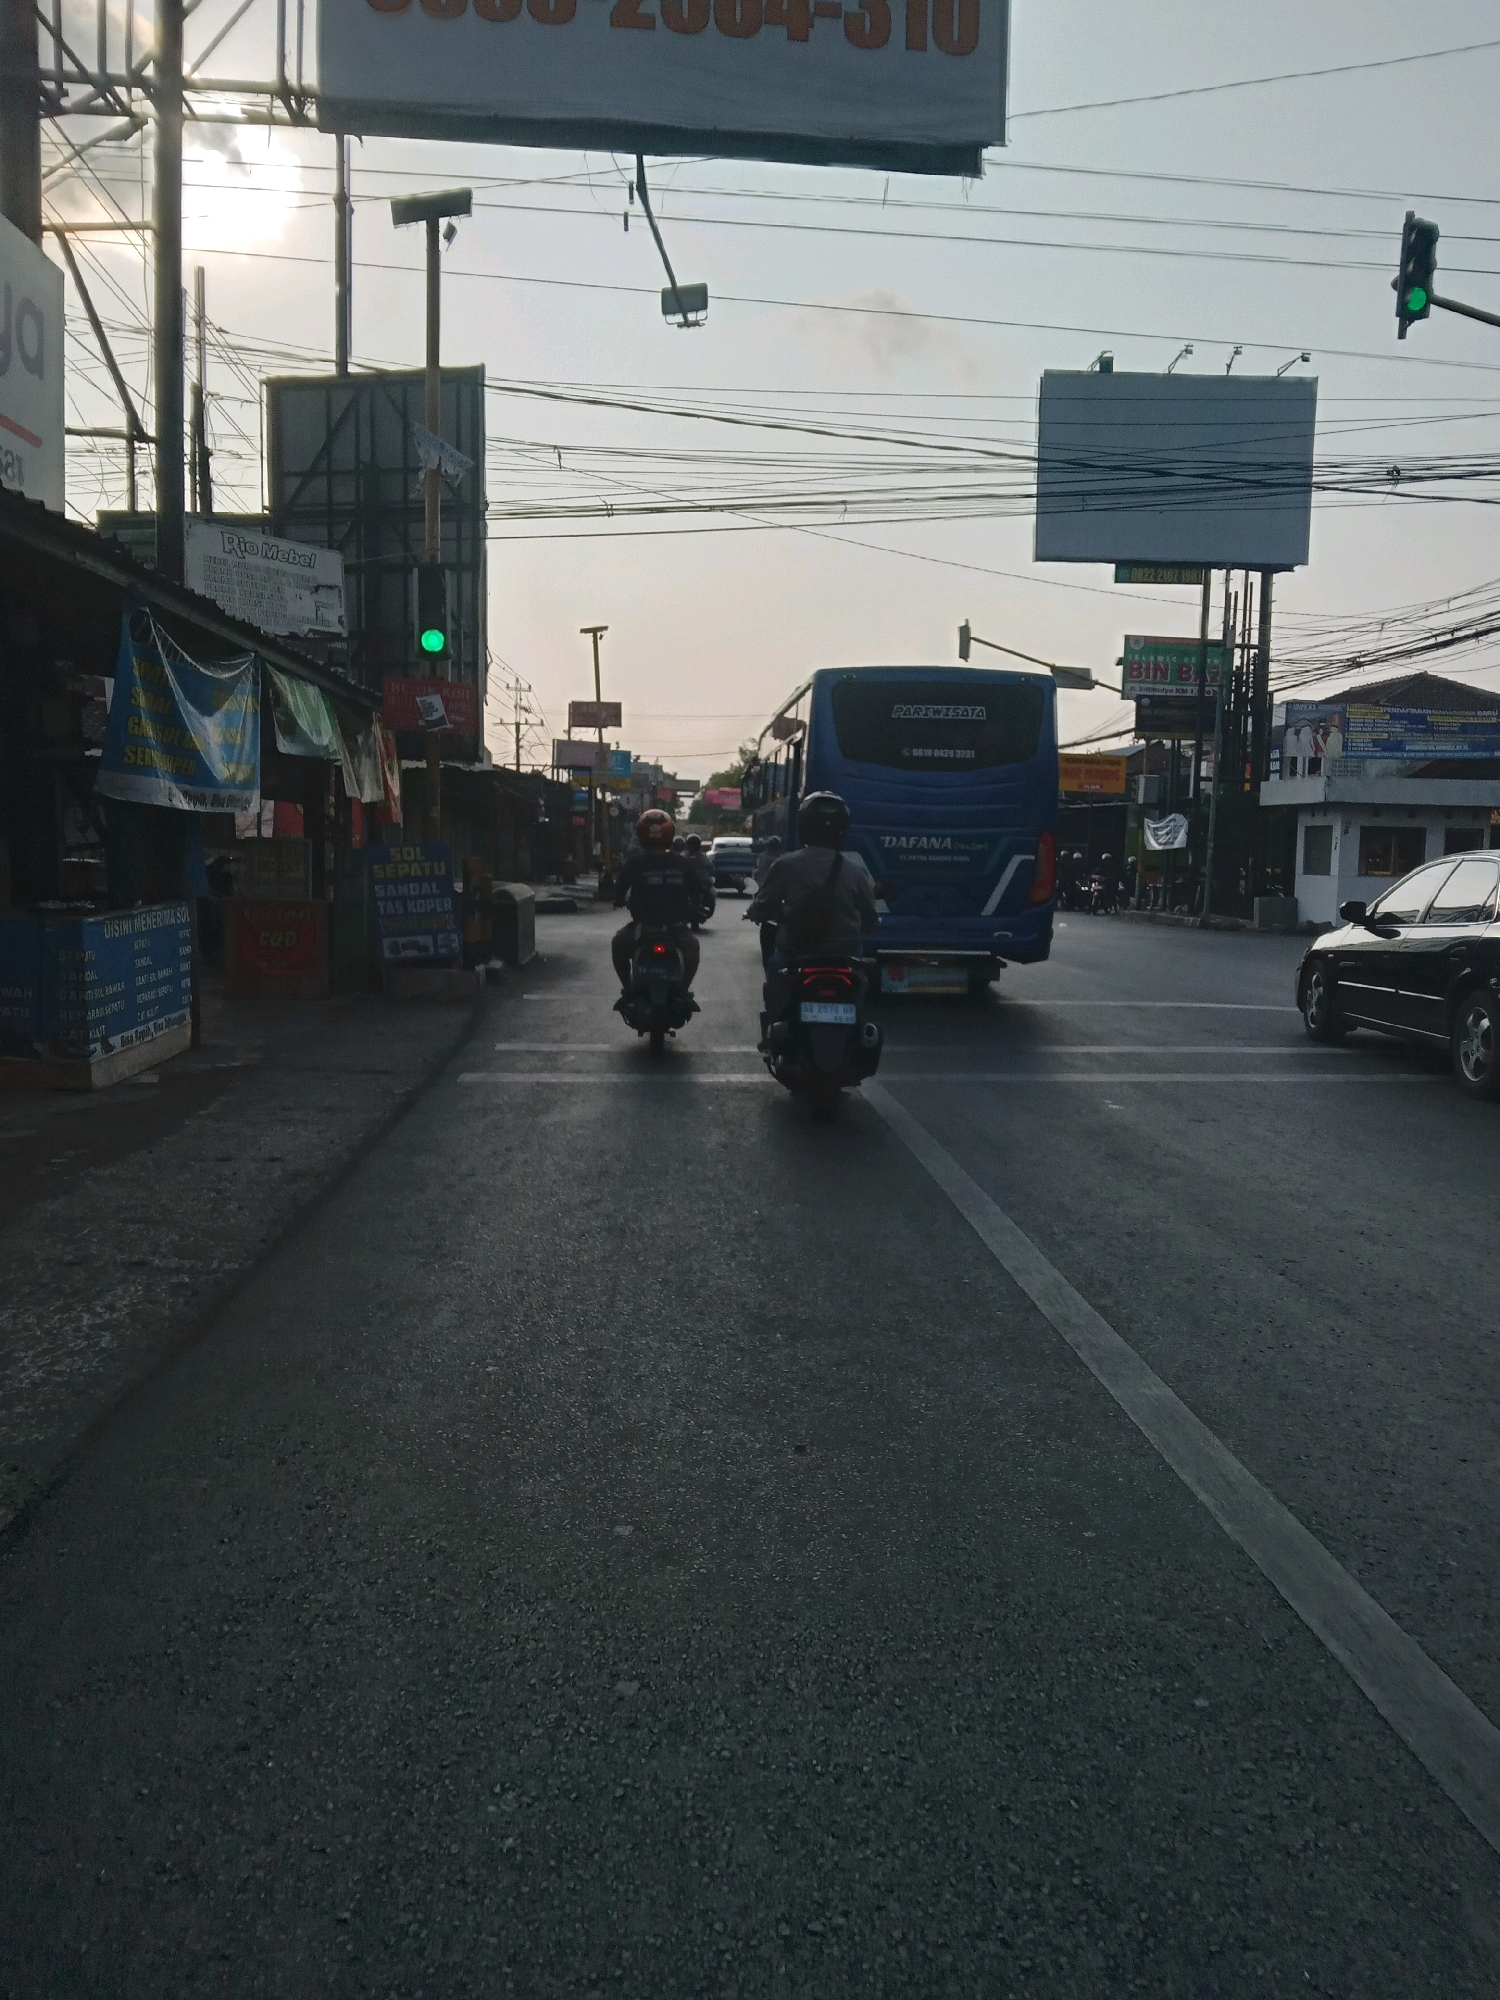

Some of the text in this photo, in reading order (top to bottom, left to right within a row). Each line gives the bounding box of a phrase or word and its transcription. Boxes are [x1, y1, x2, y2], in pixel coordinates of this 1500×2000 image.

[221, 530, 317, 568] Rio Mebel
[1127, 661, 1221, 684] BIN BZ
[892, 704, 987, 719] PARIWISATA
[880, 836, 950, 849] DAFANA
[389, 846, 425, 862] SOL
[373, 861, 446, 879] SEPATU
[374, 881, 440, 897] SANDAL
[377, 897, 453, 915] TAS KOPER
[104, 905, 191, 939] DISINI MENERIMA SOL
[259, 931, 297, 947] COD
[58, 950, 96, 962] SEPATU
